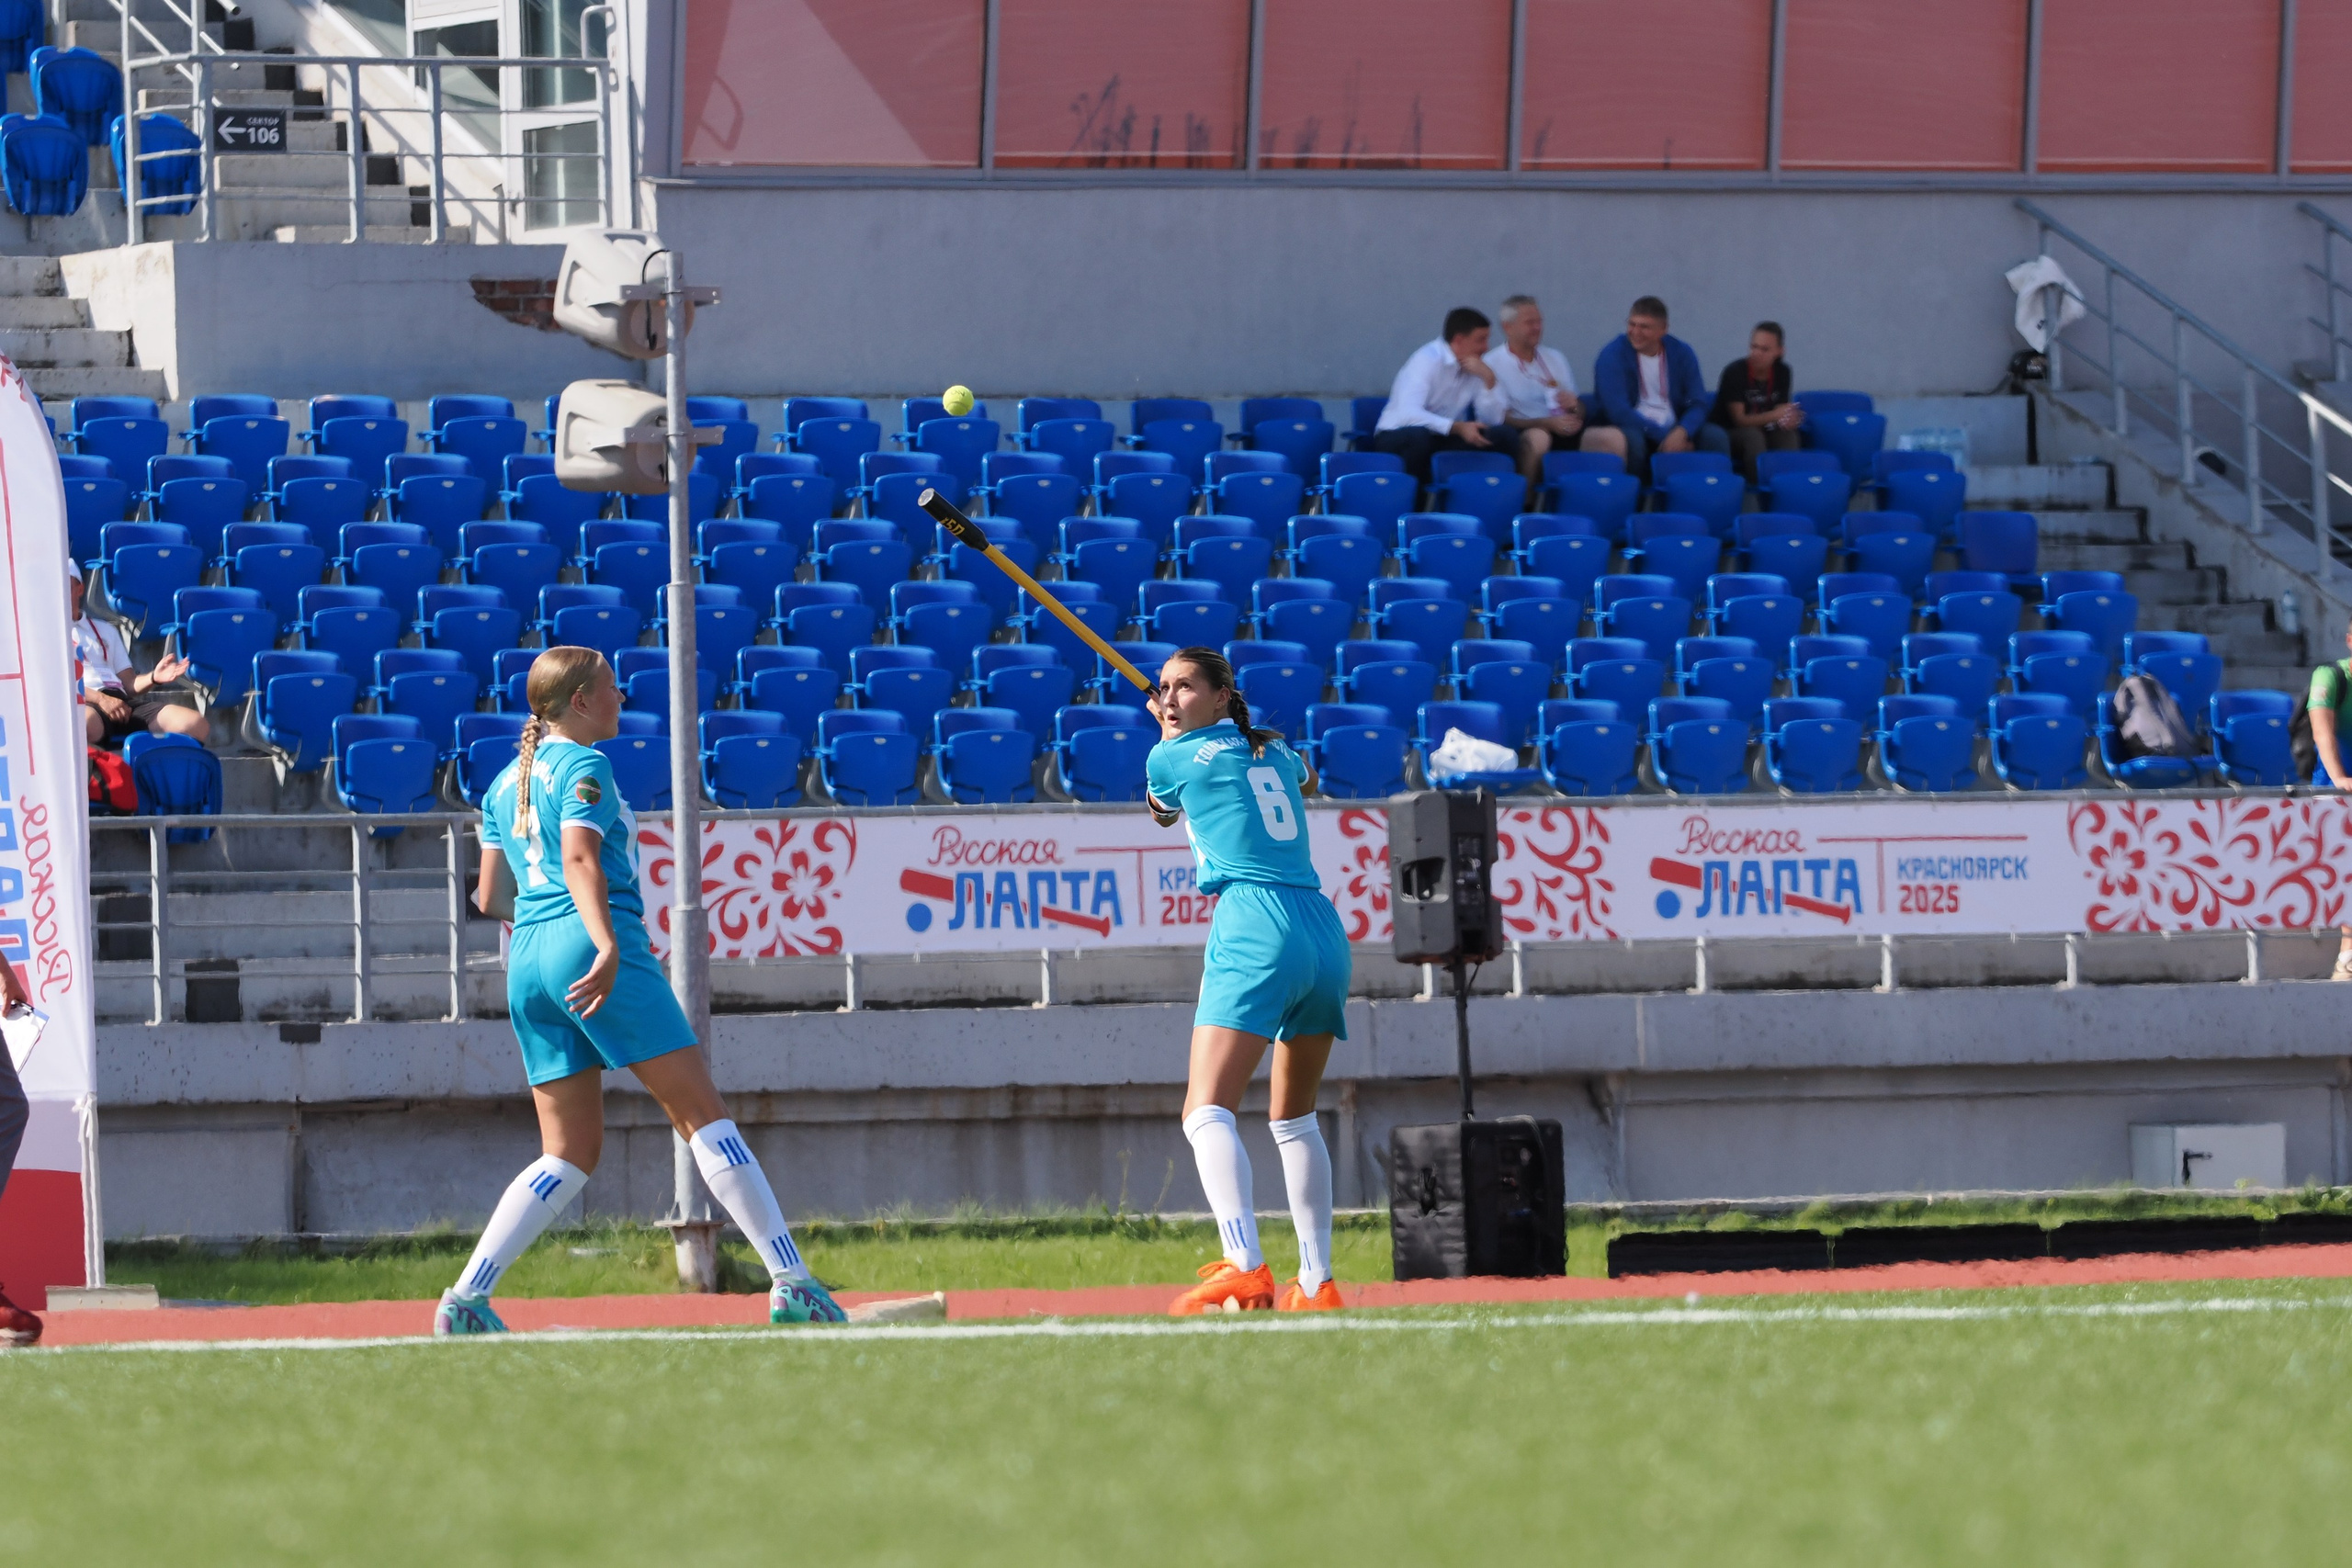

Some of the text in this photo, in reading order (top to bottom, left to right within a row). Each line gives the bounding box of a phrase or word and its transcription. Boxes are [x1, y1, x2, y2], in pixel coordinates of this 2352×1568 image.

[246, 117, 279, 126] СЕКТОР
[247, 127, 280, 144] 106
[1247, 766, 1298, 841] 6
[928, 825, 1064, 866] Русская
[1676, 814, 1806, 855] Русская
[1696, 858, 1863, 919] ЛАПТА
[1896, 856, 2030, 881] КРАСНОЯРСК
[948, 868, 1123, 931] ЛАПТА
[1899, 885, 1959, 914] 2025
